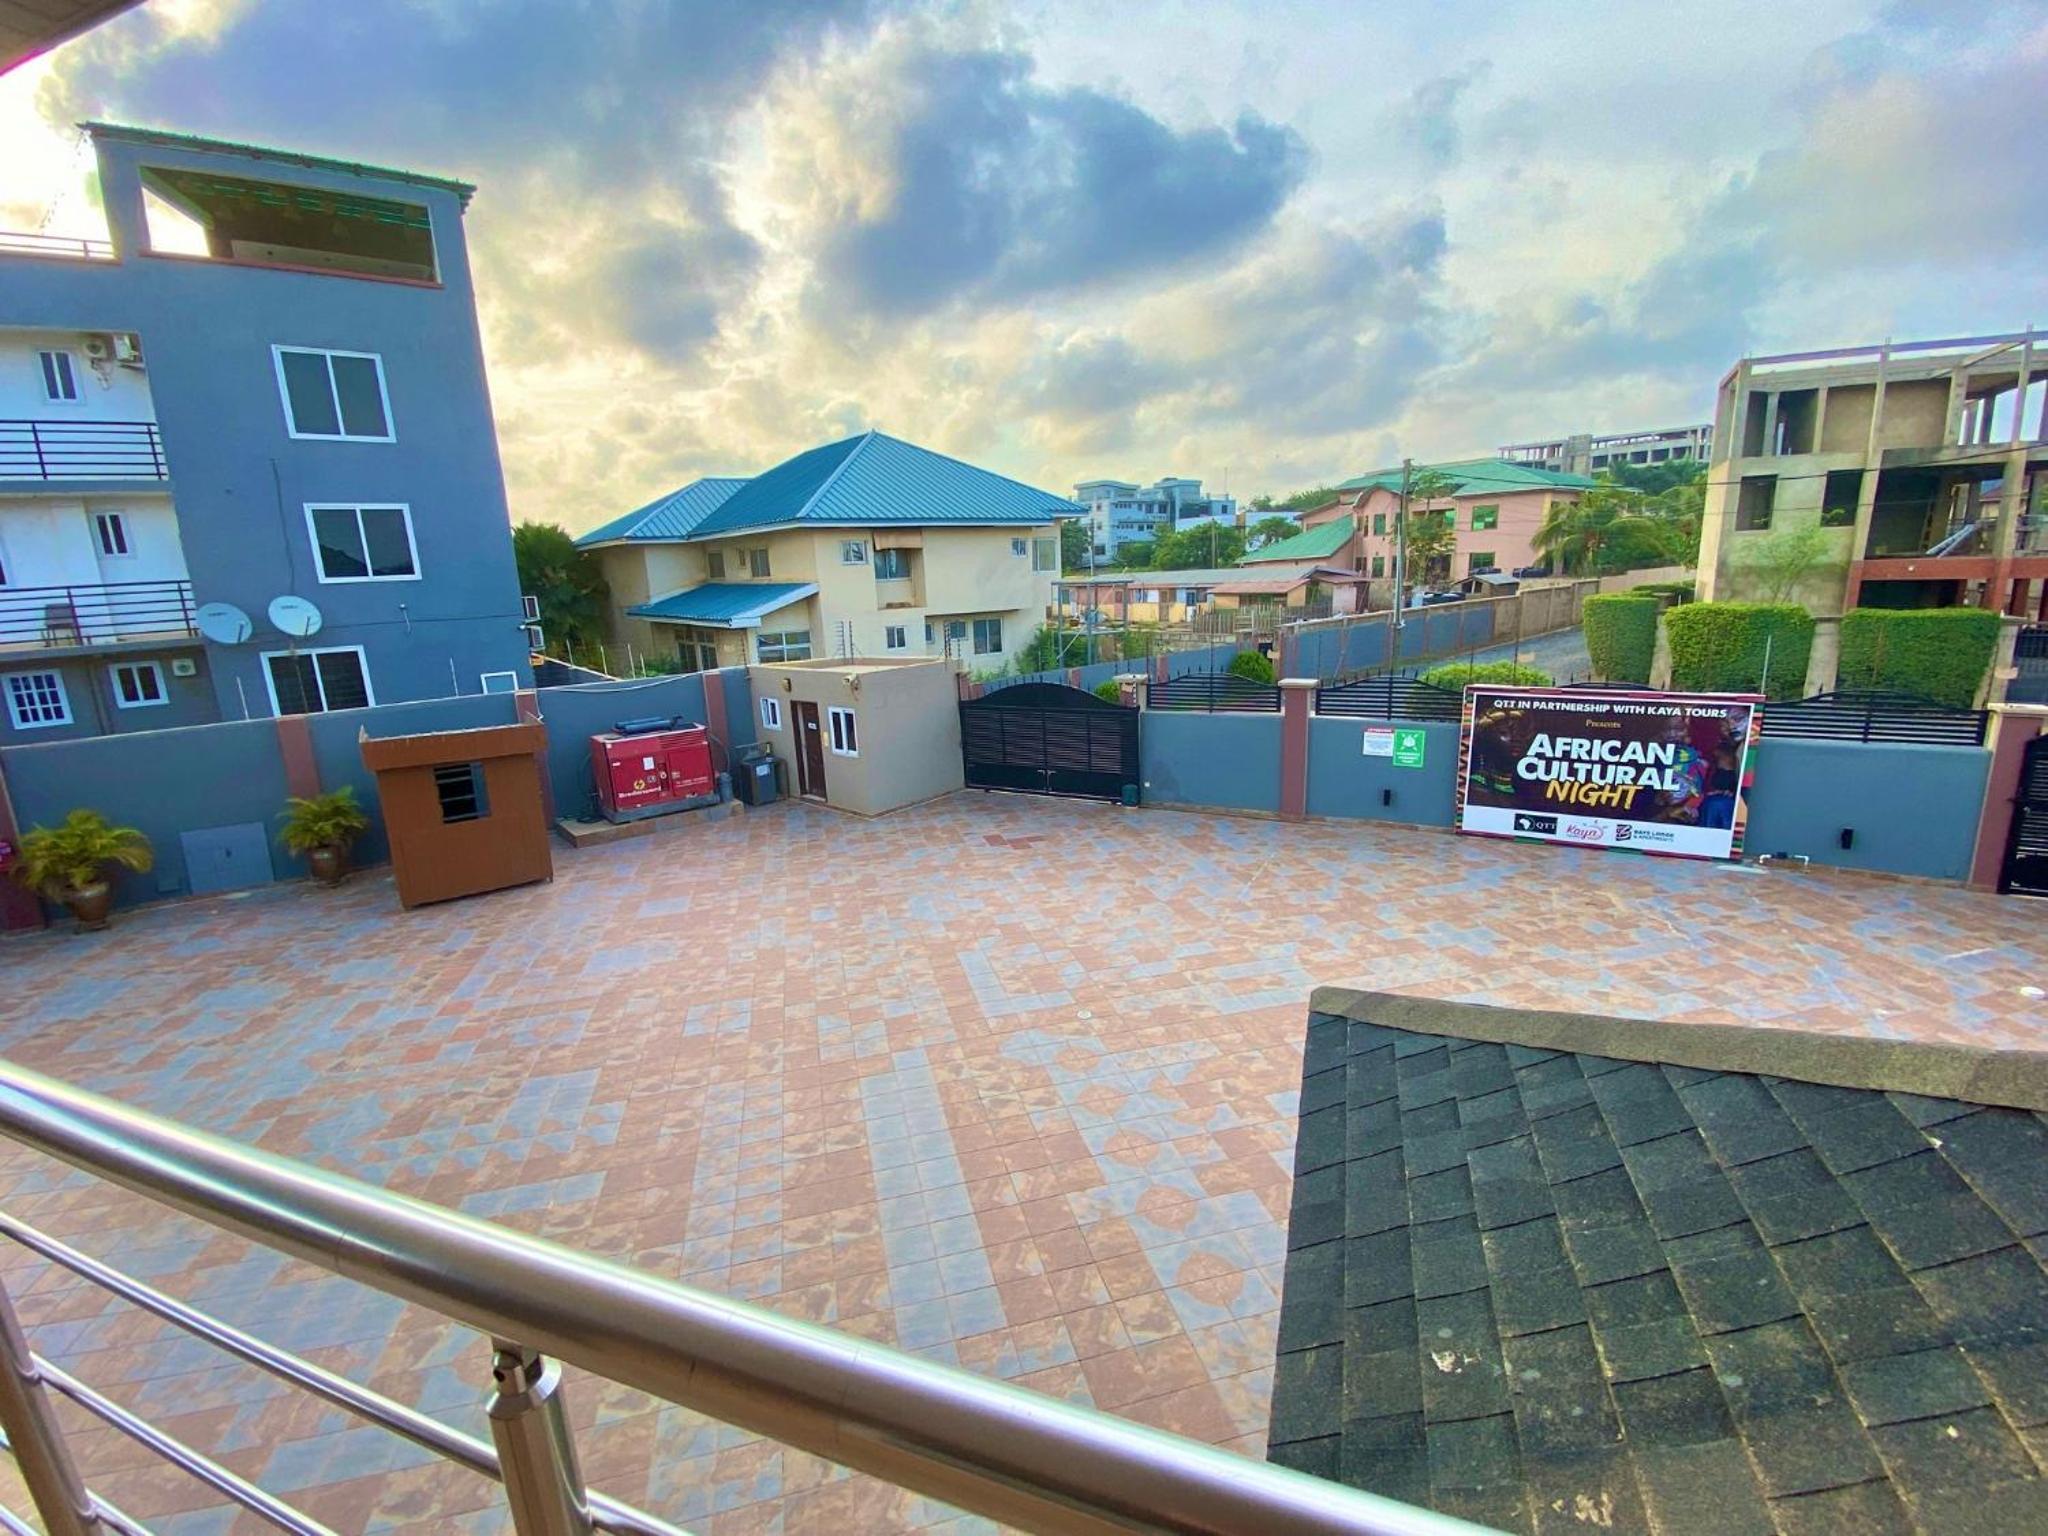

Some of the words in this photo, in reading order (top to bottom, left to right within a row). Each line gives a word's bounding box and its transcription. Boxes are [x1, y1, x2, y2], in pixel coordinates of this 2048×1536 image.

[1518, 701, 1530, 709] IN
[1533, 701, 1610, 713] PARTNERSHIP
[1613, 704, 1645, 715] WITH
[1647, 705, 1682, 716] KAYA
[1685, 707, 1728, 718] TOURS
[1526, 733, 1675, 765] AFRICAN
[1516, 756, 1680, 791] CULTURAL
[1546, 780, 1643, 810] NIGHT
